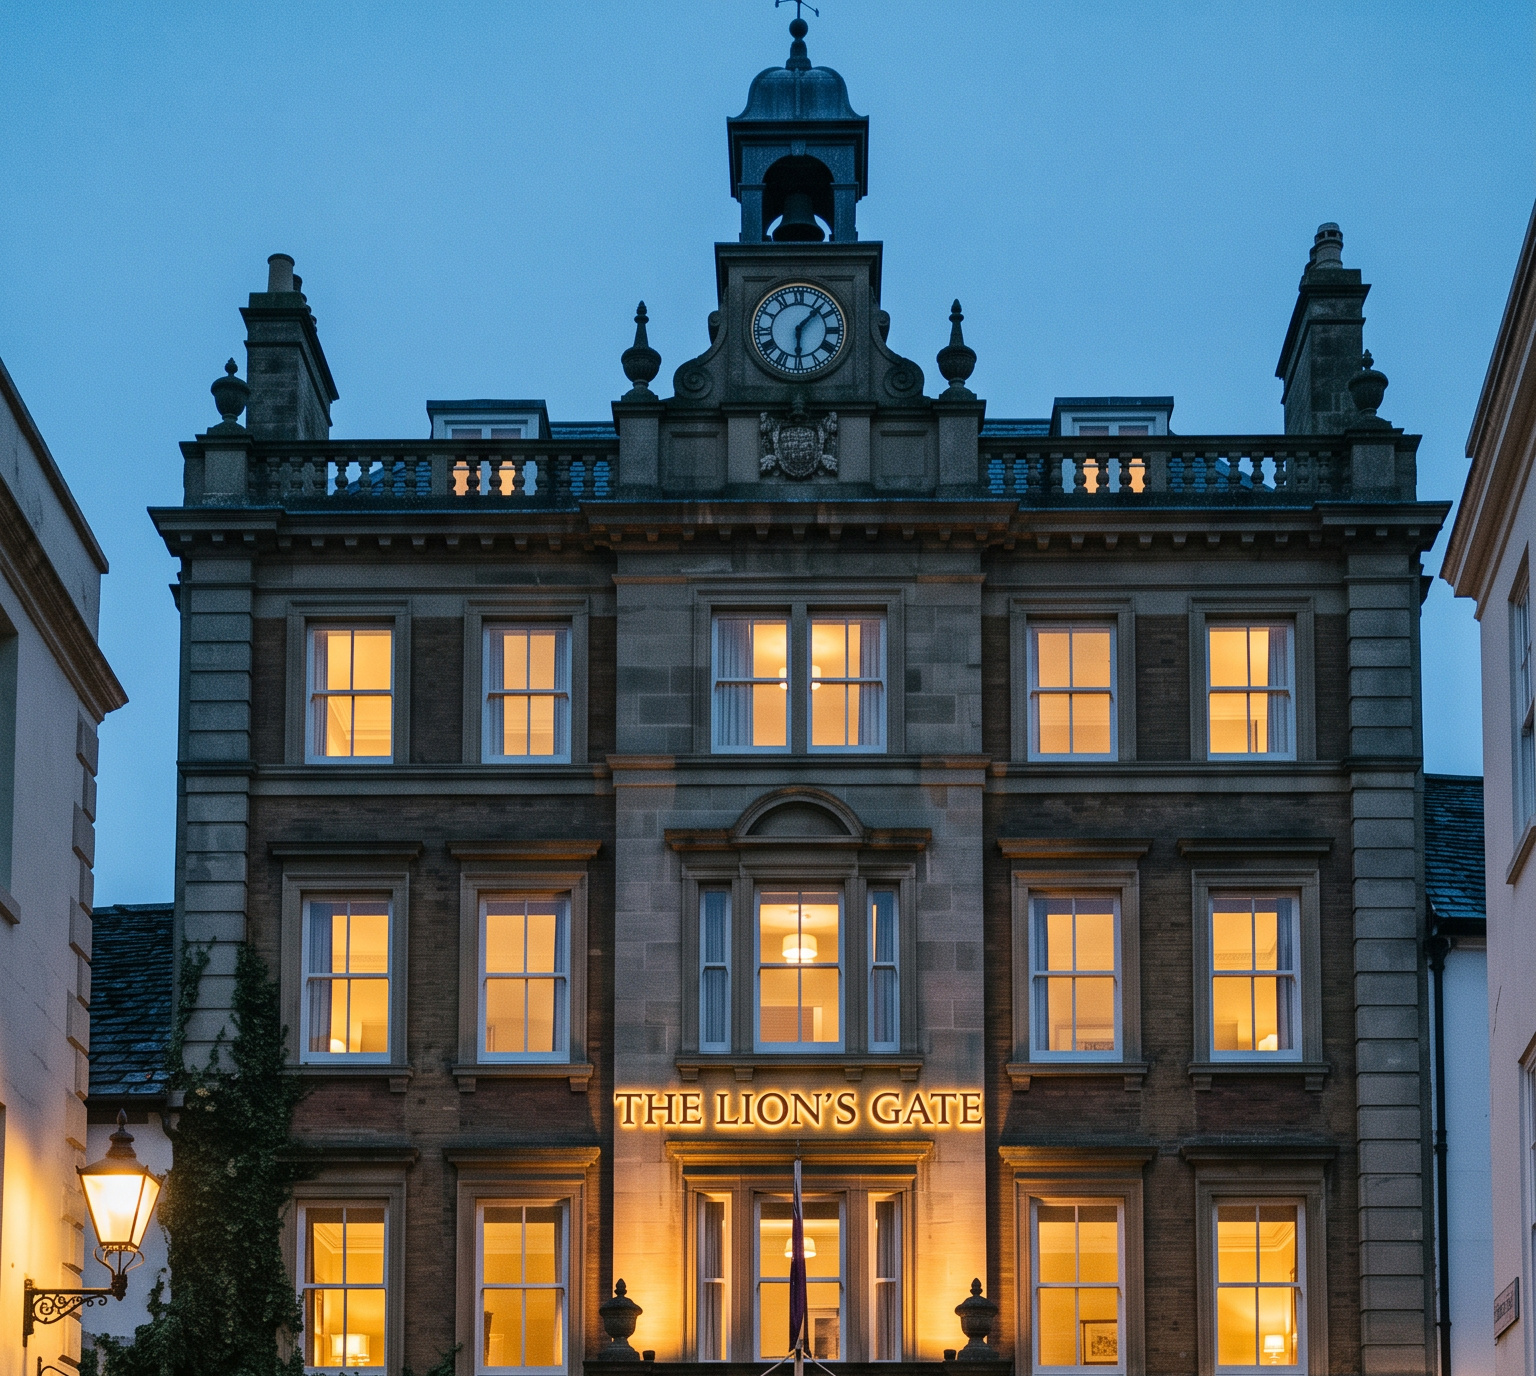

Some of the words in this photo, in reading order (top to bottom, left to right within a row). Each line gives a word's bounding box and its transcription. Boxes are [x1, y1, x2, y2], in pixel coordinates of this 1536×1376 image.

[615, 1093, 702, 1125] THE
[716, 1092, 857, 1125] LION'S
[871, 1092, 983, 1125] GATE
